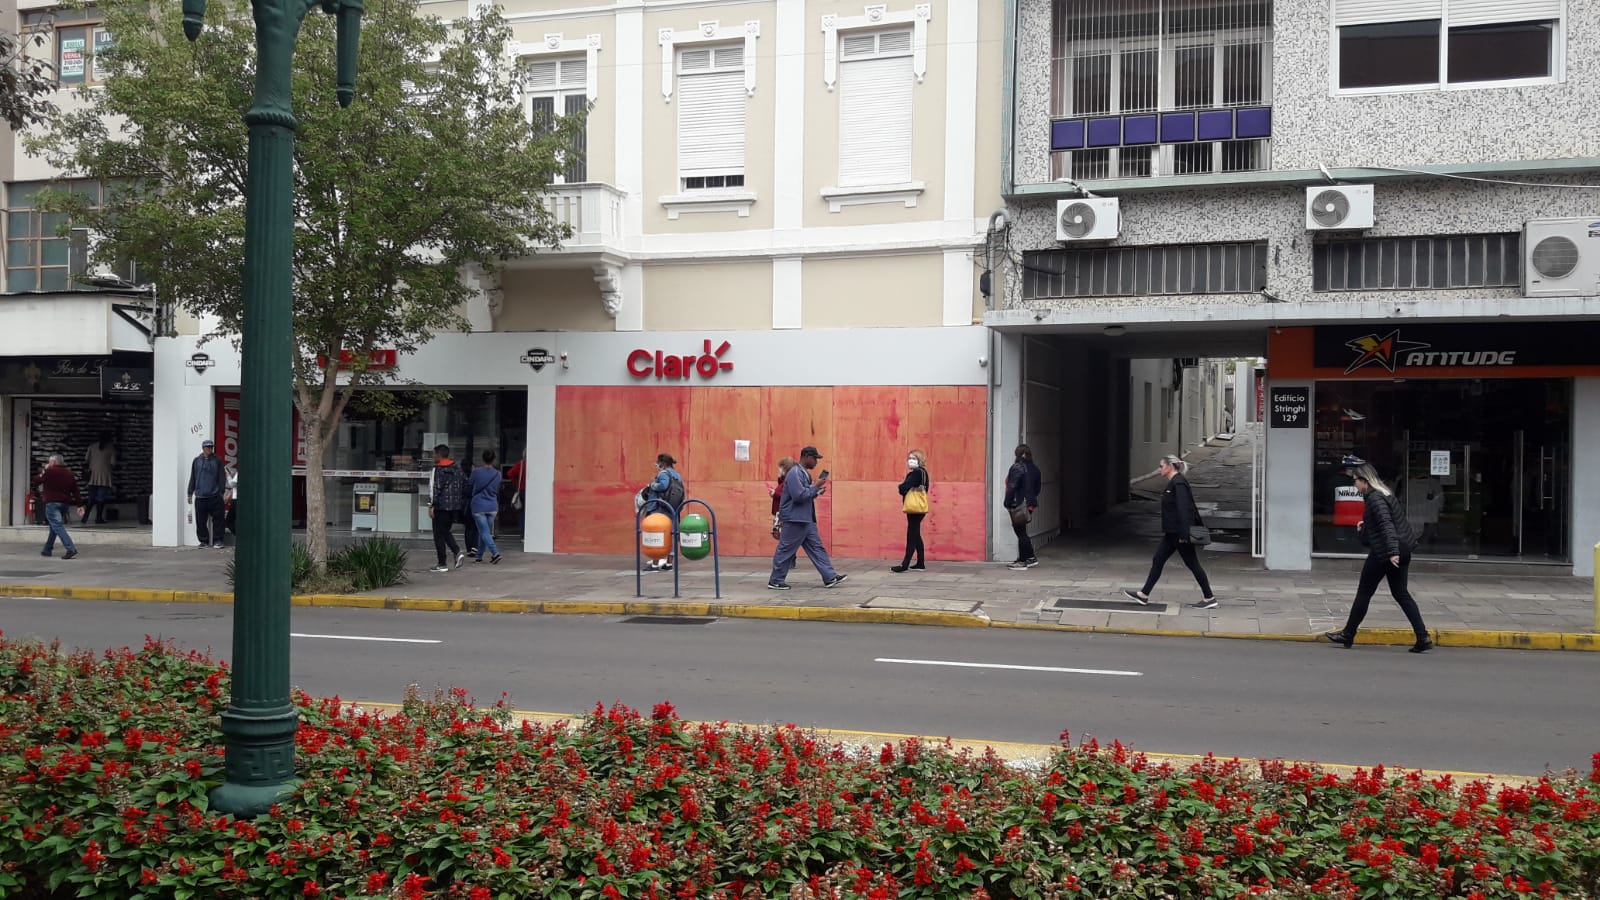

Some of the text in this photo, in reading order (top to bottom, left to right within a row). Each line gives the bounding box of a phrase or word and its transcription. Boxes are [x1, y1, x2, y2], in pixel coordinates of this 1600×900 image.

[627, 339, 734, 378] Claro
[1406, 351, 1516, 366] ATITUDE
[1274, 405, 1306, 414] Stringhi
